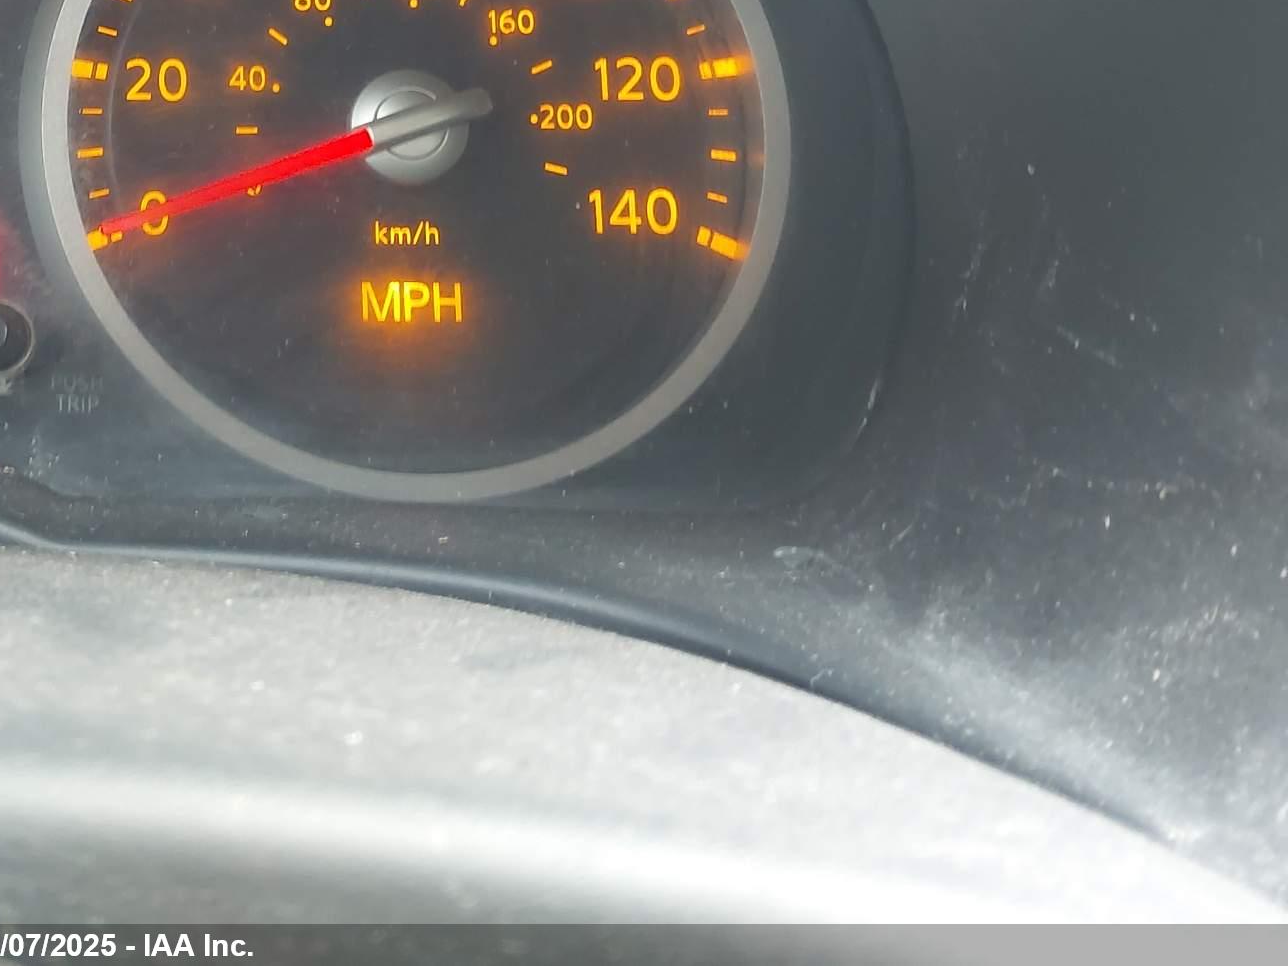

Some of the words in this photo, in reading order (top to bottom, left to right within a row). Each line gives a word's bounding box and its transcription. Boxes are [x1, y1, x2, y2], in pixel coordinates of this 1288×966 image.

[487, 9, 535, 35] 160
[125, 57, 188, 102] 20
[228, 66, 266, 93] 40
[593, 57, 682, 102] 120
[540, 103, 594, 130] 200
[140, 190, 169, 236] 0
[588, 188, 678, 236] 140
[373, 221, 441, 248] km/h
[361, 280, 465, 324] MPH
